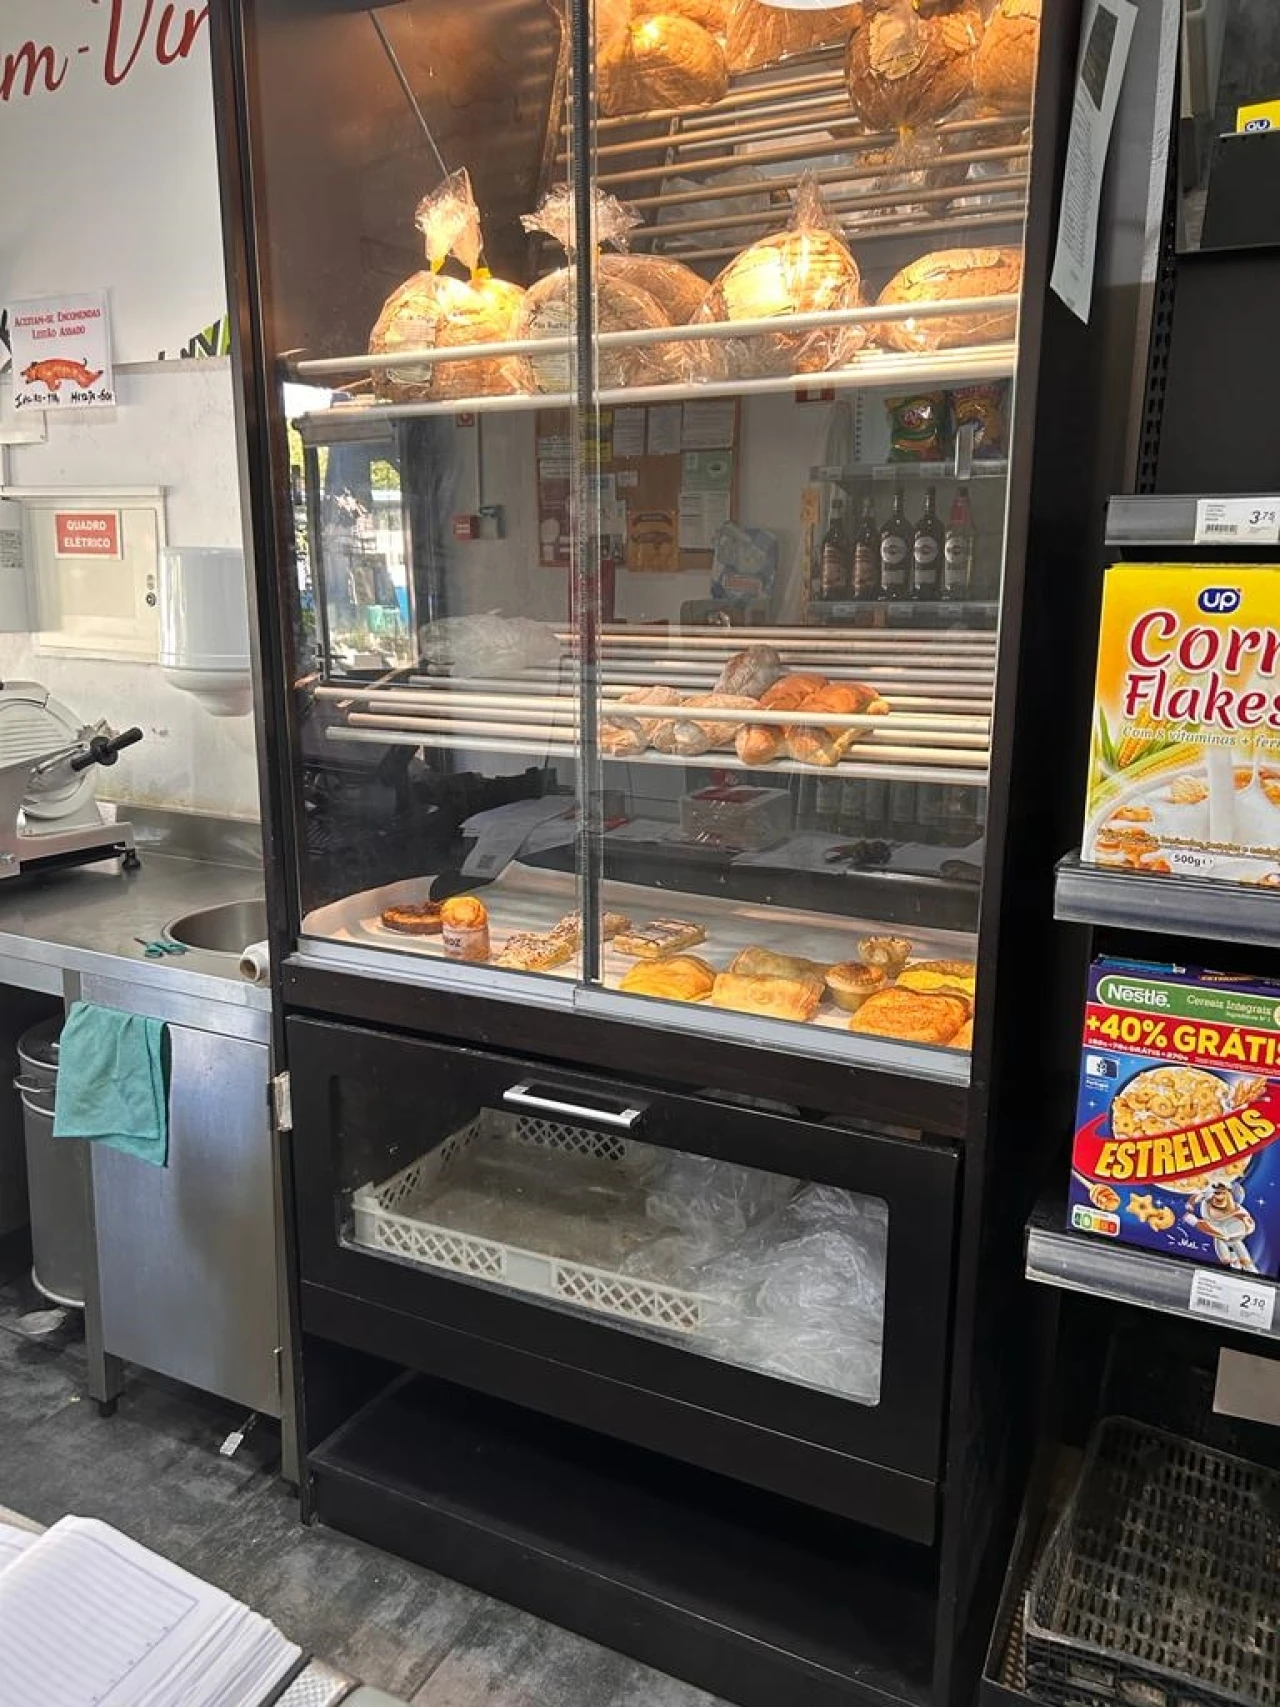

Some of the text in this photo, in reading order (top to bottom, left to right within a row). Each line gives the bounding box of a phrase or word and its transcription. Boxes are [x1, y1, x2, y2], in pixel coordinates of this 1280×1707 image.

[66, 519, 107, 531] QUADRO
[1202, 591, 1237, 611] up
[1169, 730, 1236, 746] vitaminas
[1187, 994, 1224, 1010] Cereais
[1226, 1000, 1272, 1016] Integrais
[1087, 1014, 1280, 1066] +40% GRÁTI
[1095, 1109, 1275, 1179] ESTRELITAS
